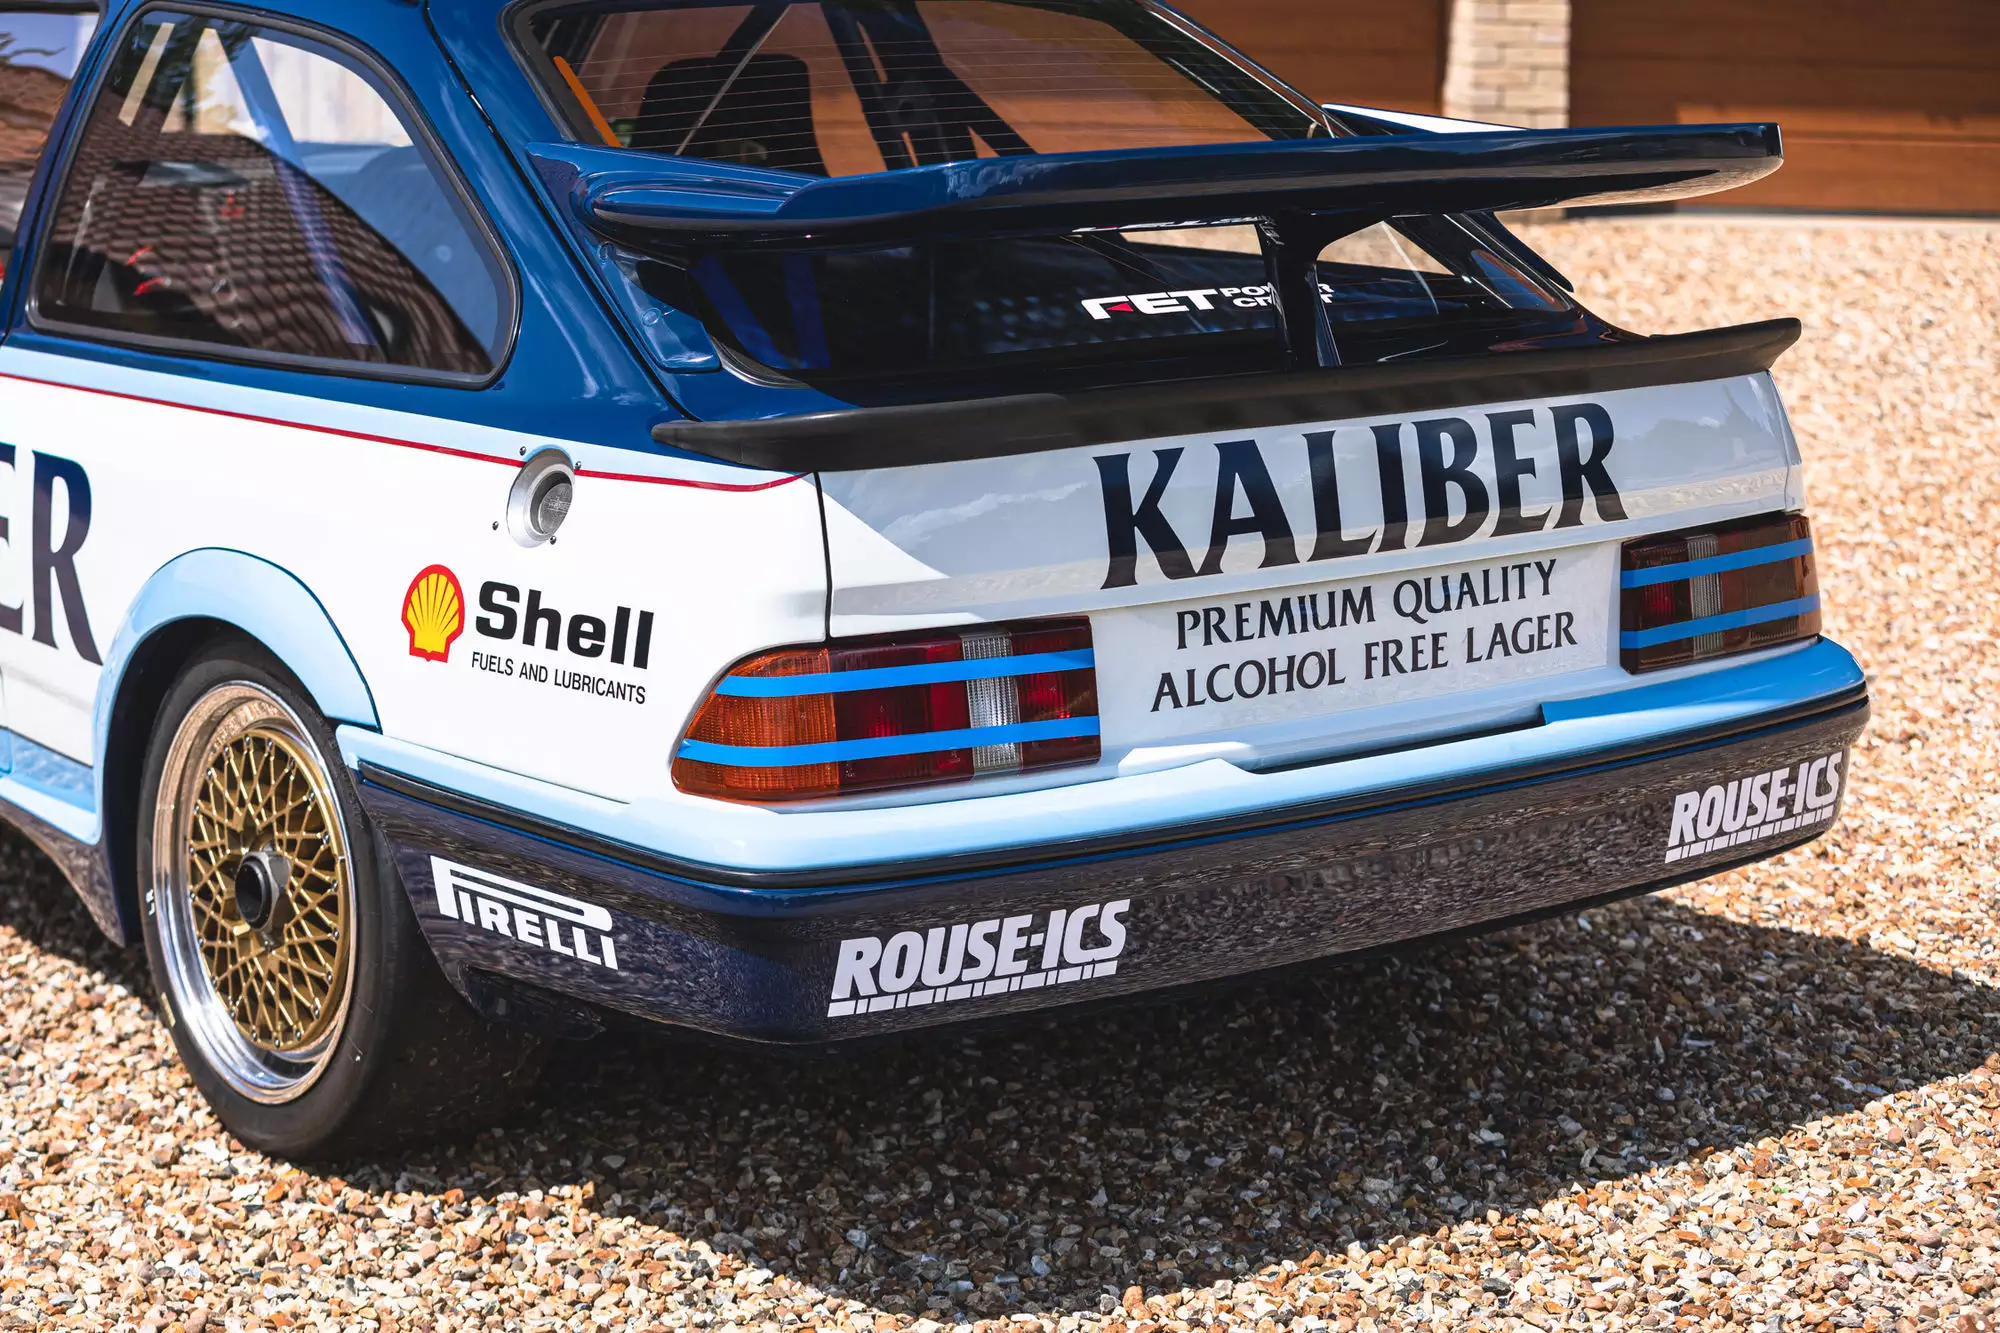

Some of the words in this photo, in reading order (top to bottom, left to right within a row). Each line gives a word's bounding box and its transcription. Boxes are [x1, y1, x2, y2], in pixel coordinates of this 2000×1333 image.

[1081, 288, 1219, 320] FET
[1219, 283, 1335, 297] POR
[1092, 402, 1629, 590] KALIBER
[475, 580, 655, 670] Shell
[1176, 585, 1375, 650] PREMIUM
[1393, 558, 1557, 621] QUALITY
[471, 651, 514, 677] FUELS
[519, 662, 549, 684] AND
[554, 669, 646, 705] LUBRICANTS
[1149, 648, 1346, 713] ALCOHOL
[1364, 632, 1449, 680] FREE
[1465, 611, 1578, 663] LAGER
[1667, 751, 1843, 848] ROUSE-ICS
[429, 855, 619, 970] PIRELLI
[831, 899, 1131, 1000] ROUSE-ICS
